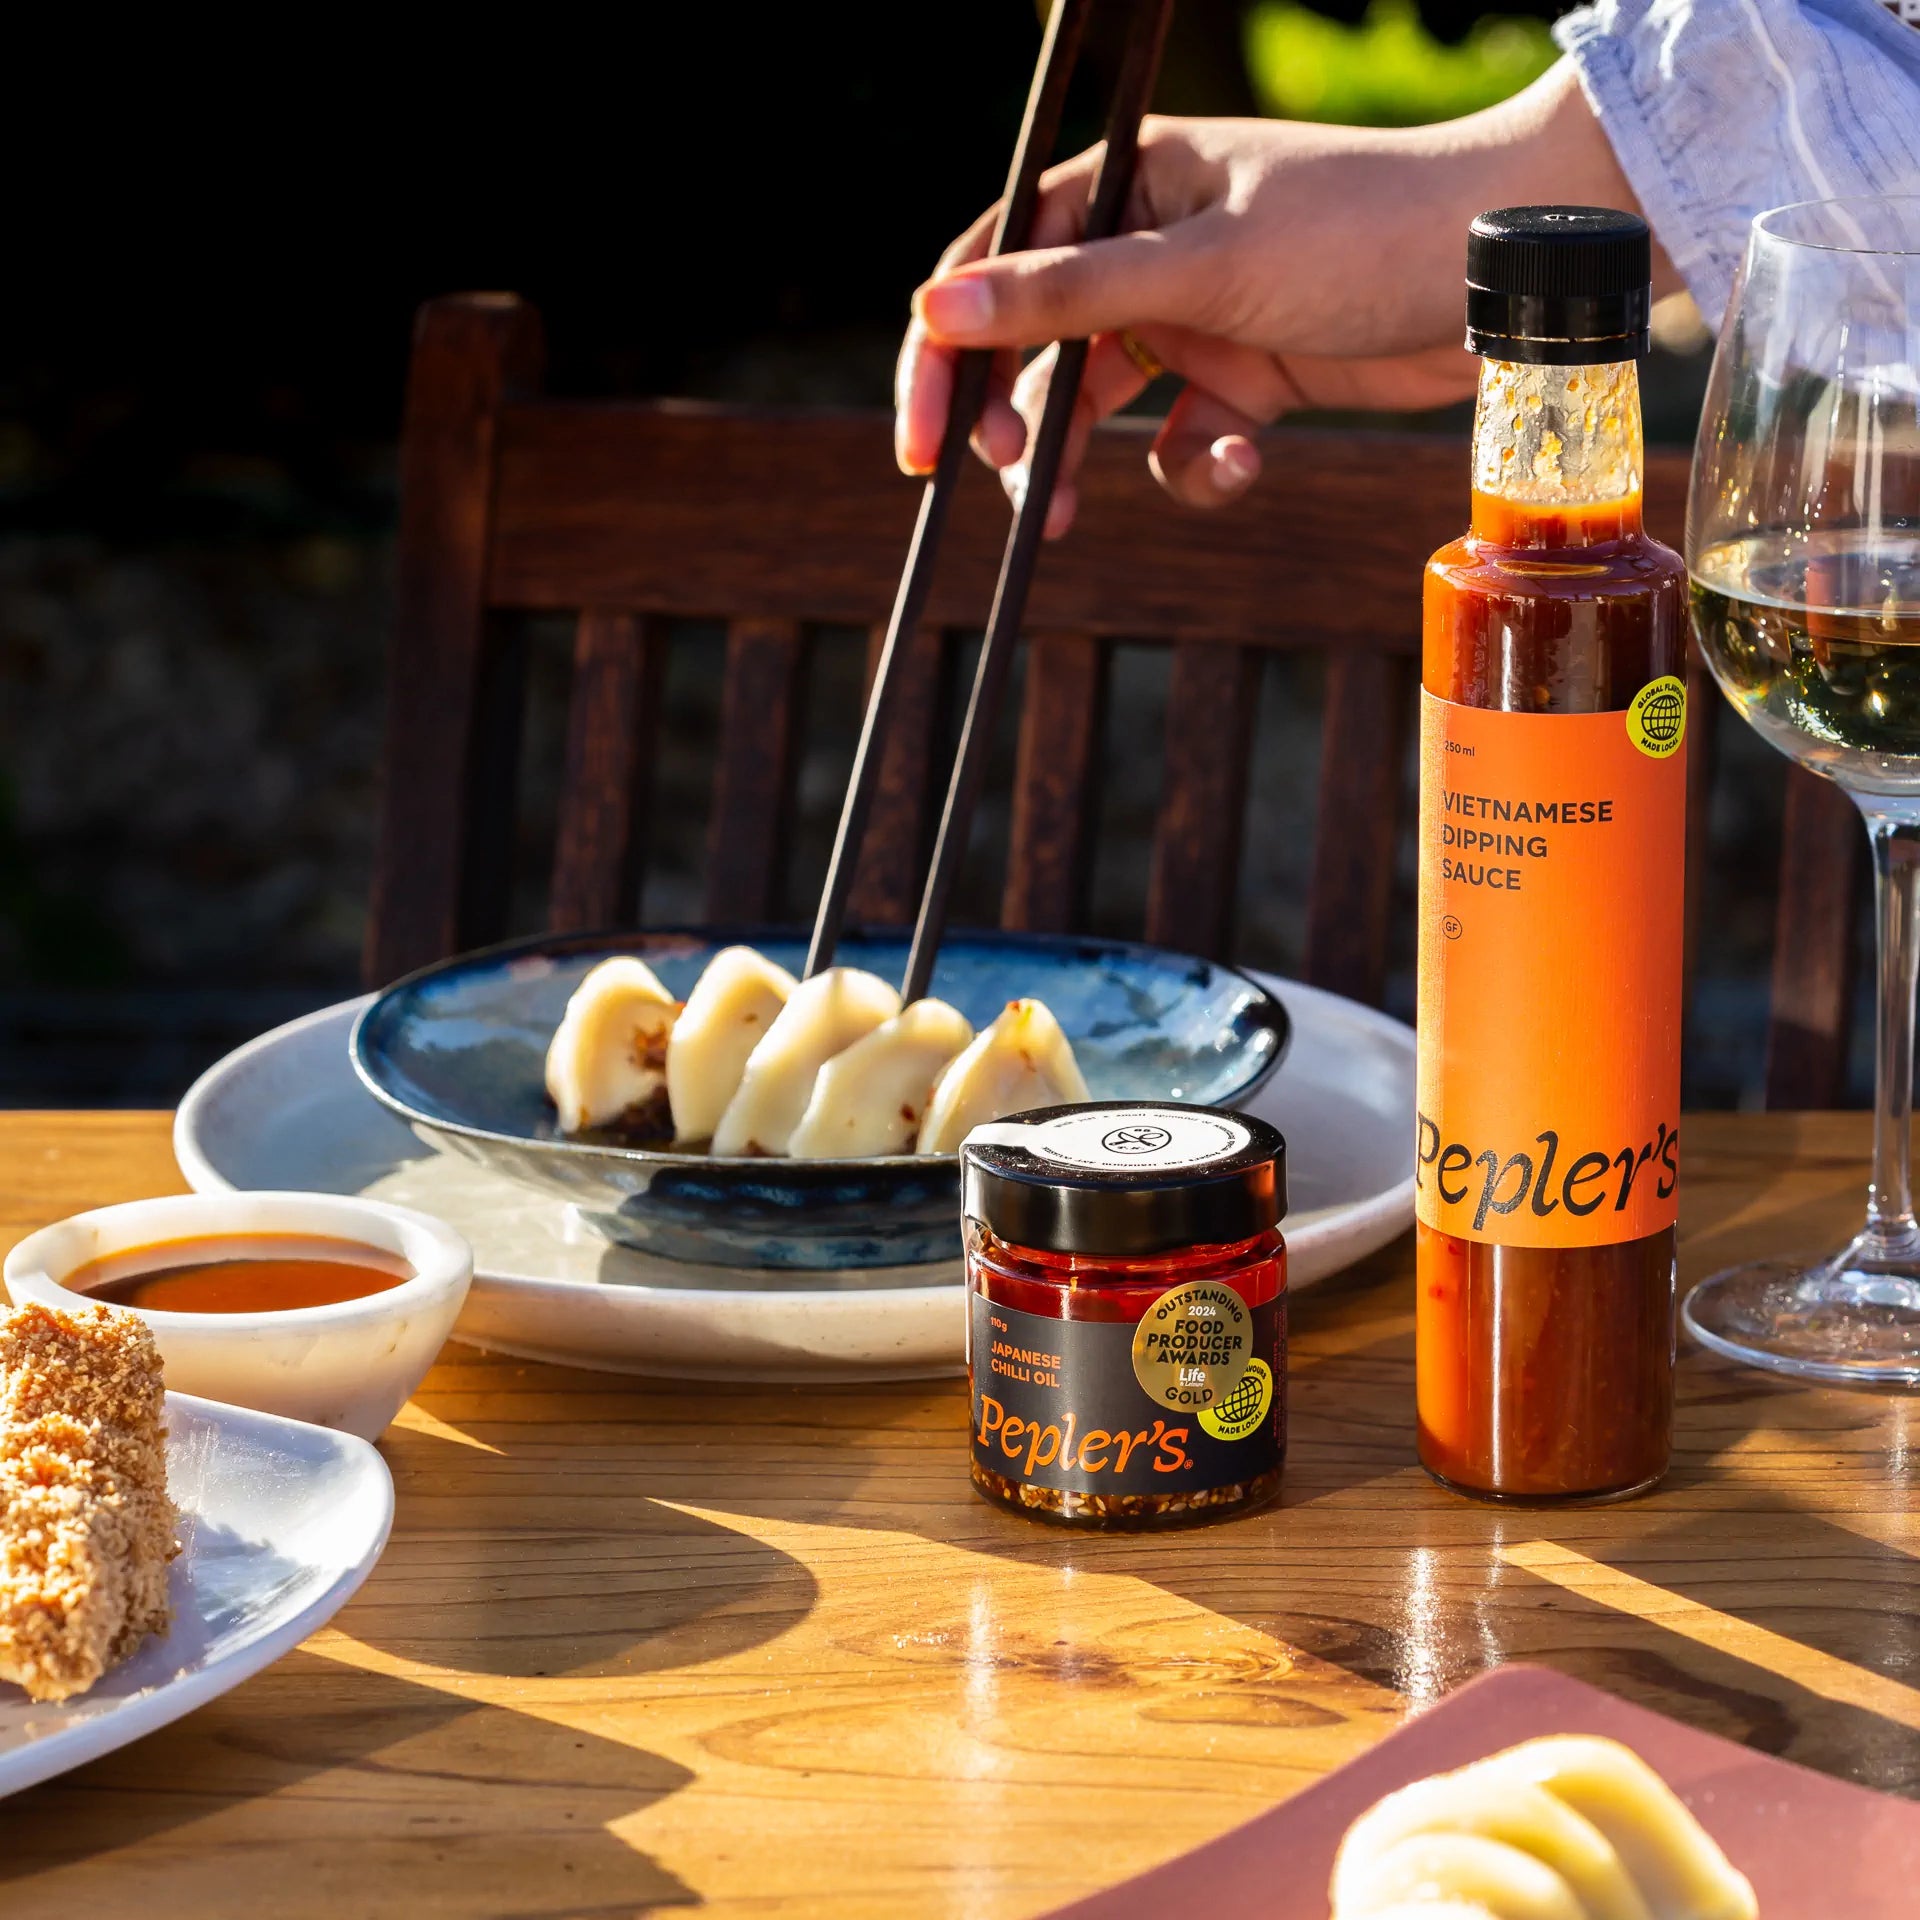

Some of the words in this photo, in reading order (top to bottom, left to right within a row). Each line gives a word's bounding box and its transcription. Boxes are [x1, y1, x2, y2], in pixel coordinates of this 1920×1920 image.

[1637, 684, 1664, 709] GLOBAL
[1640, 737, 1660, 752] MADE
[1661, 737, 1678, 752] LOCAL
[1443, 789, 1613, 824] VIETNAMESE
[1443, 823, 1548, 858] DIPPING
[1442, 857, 1521, 891] SAUCE
[1416, 1110, 1678, 1231] Pepler's
[1156, 1288, 1243, 1324] OUTSTANDING
[1187, 1305, 1217, 1317] 2024
[1174, 1319, 1225, 1335] FOOD
[1146, 1333, 1243, 1350] PRODUCER
[991, 1340, 1062, 1370] JAPANESE
[1156, 1349, 1230, 1366] AWARDS
[991, 1358, 1030, 1382] CHILLI
[1033, 1370, 1061, 1388] OIL
[1179, 1367, 1206, 1382] Life
[1245, 1365, 1267, 1380] AVOURS
[1165, 1386, 1214, 1405] GOLD
[1217, 1425, 1241, 1435] MADE
[1241, 1410, 1263, 1432] LOCAL
